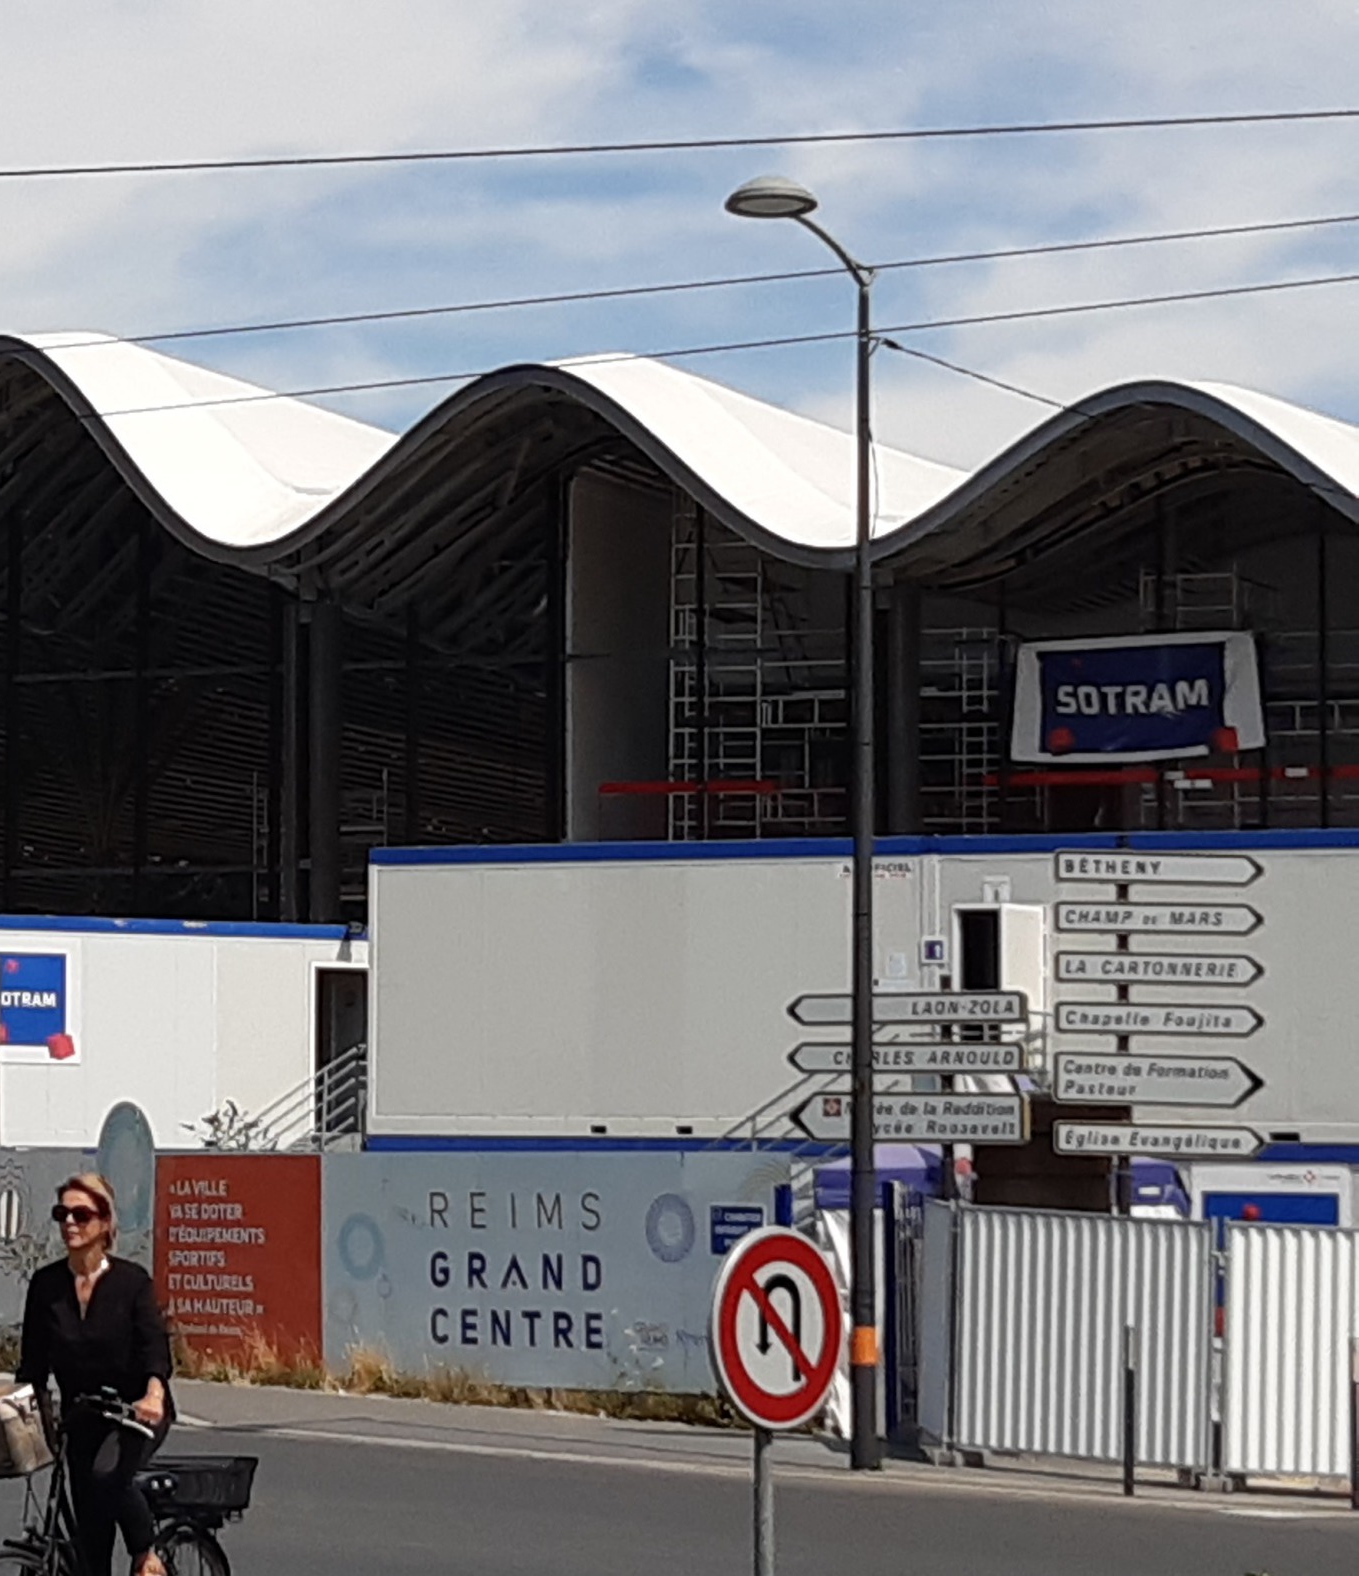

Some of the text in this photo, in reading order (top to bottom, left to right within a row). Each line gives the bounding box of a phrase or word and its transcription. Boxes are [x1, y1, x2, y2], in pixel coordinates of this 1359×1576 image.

[1056, 678, 1210, 716] SOTRAM
[1064, 857, 1161, 875] BÉTHENY
[1065, 909, 1133, 924] CHAMP
[1169, 911, 1223, 926] MARS
[1065, 959, 1236, 978] LA CARTONNERIE
[911, 1000, 1015, 1016] LAON-ZOLA
[1065, 1010, 1232, 1030] Chapelle Foujita
[926, 1050, 1015, 1066] ARNOULD
[1063, 1060, 1230, 1080] Centre de Formation
[1063, 1080, 1136, 1096] Pasteur
[900, 1101, 920, 1115] de
[923, 1101, 938, 1115] la
[943, 1101, 1015, 1116] Reddition
[872, 1120, 1016, 1136] ycée Roosevelt
[1065, 1130, 1120, 1148] Église
[191, 1180, 228, 1197] VILLE
[184, 1203, 199, 1219] SE
[200, 1203, 243, 1220] DOTER
[429, 1192, 601, 1231] REIMS
[168, 1250, 225, 1267] SPORTIFS
[430, 1251, 601, 1291] GRAND
[168, 1273, 254, 1293] ET CULTURELS
[176, 1298, 192, 1314] SA
[193, 1298, 254, 1316] HAUTEUR
[431, 1308, 603, 1349] CENTRE
